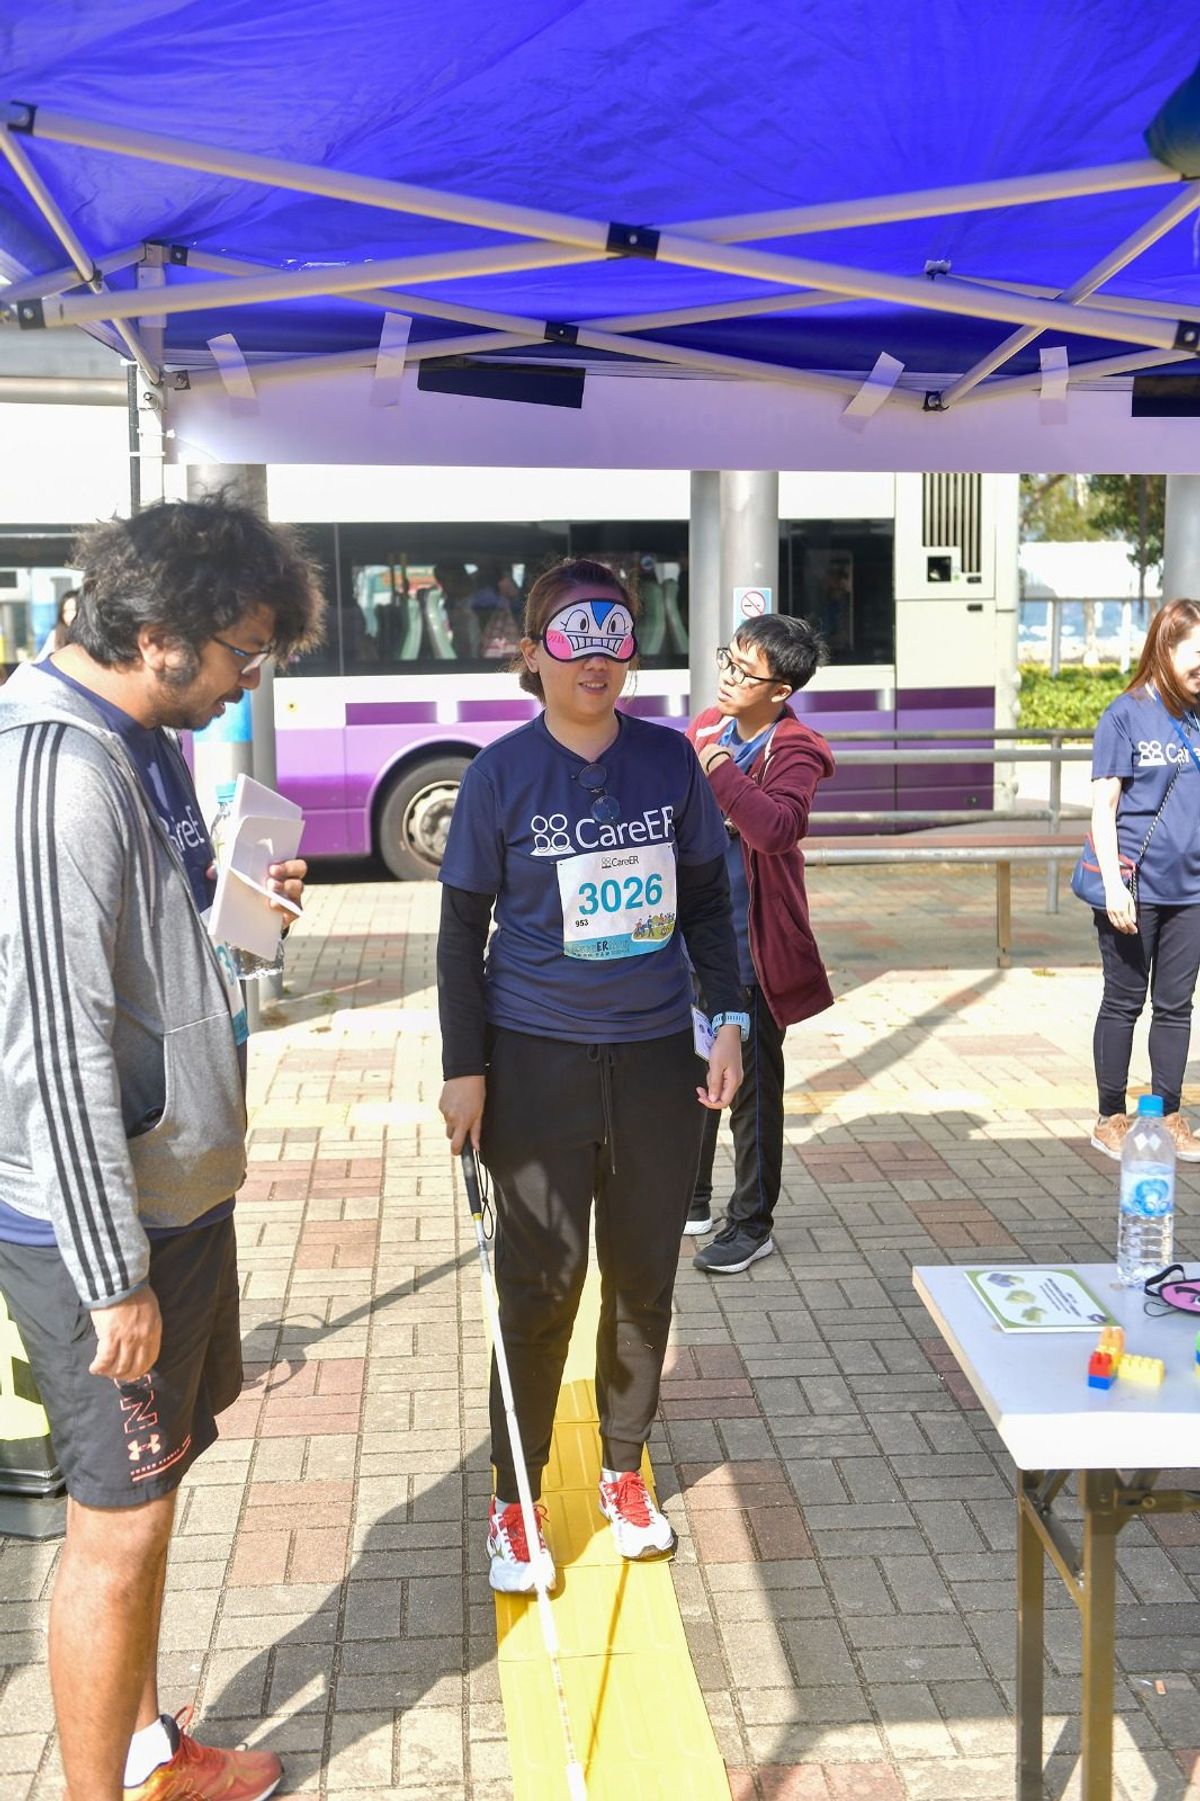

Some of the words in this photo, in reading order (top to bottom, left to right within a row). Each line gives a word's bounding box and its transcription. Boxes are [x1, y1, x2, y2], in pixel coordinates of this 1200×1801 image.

[575, 805, 675, 849] CareER
[611, 855, 640, 867] CareER
[578, 873, 663, 916] 3026
[575, 919, 589, 927] 953
